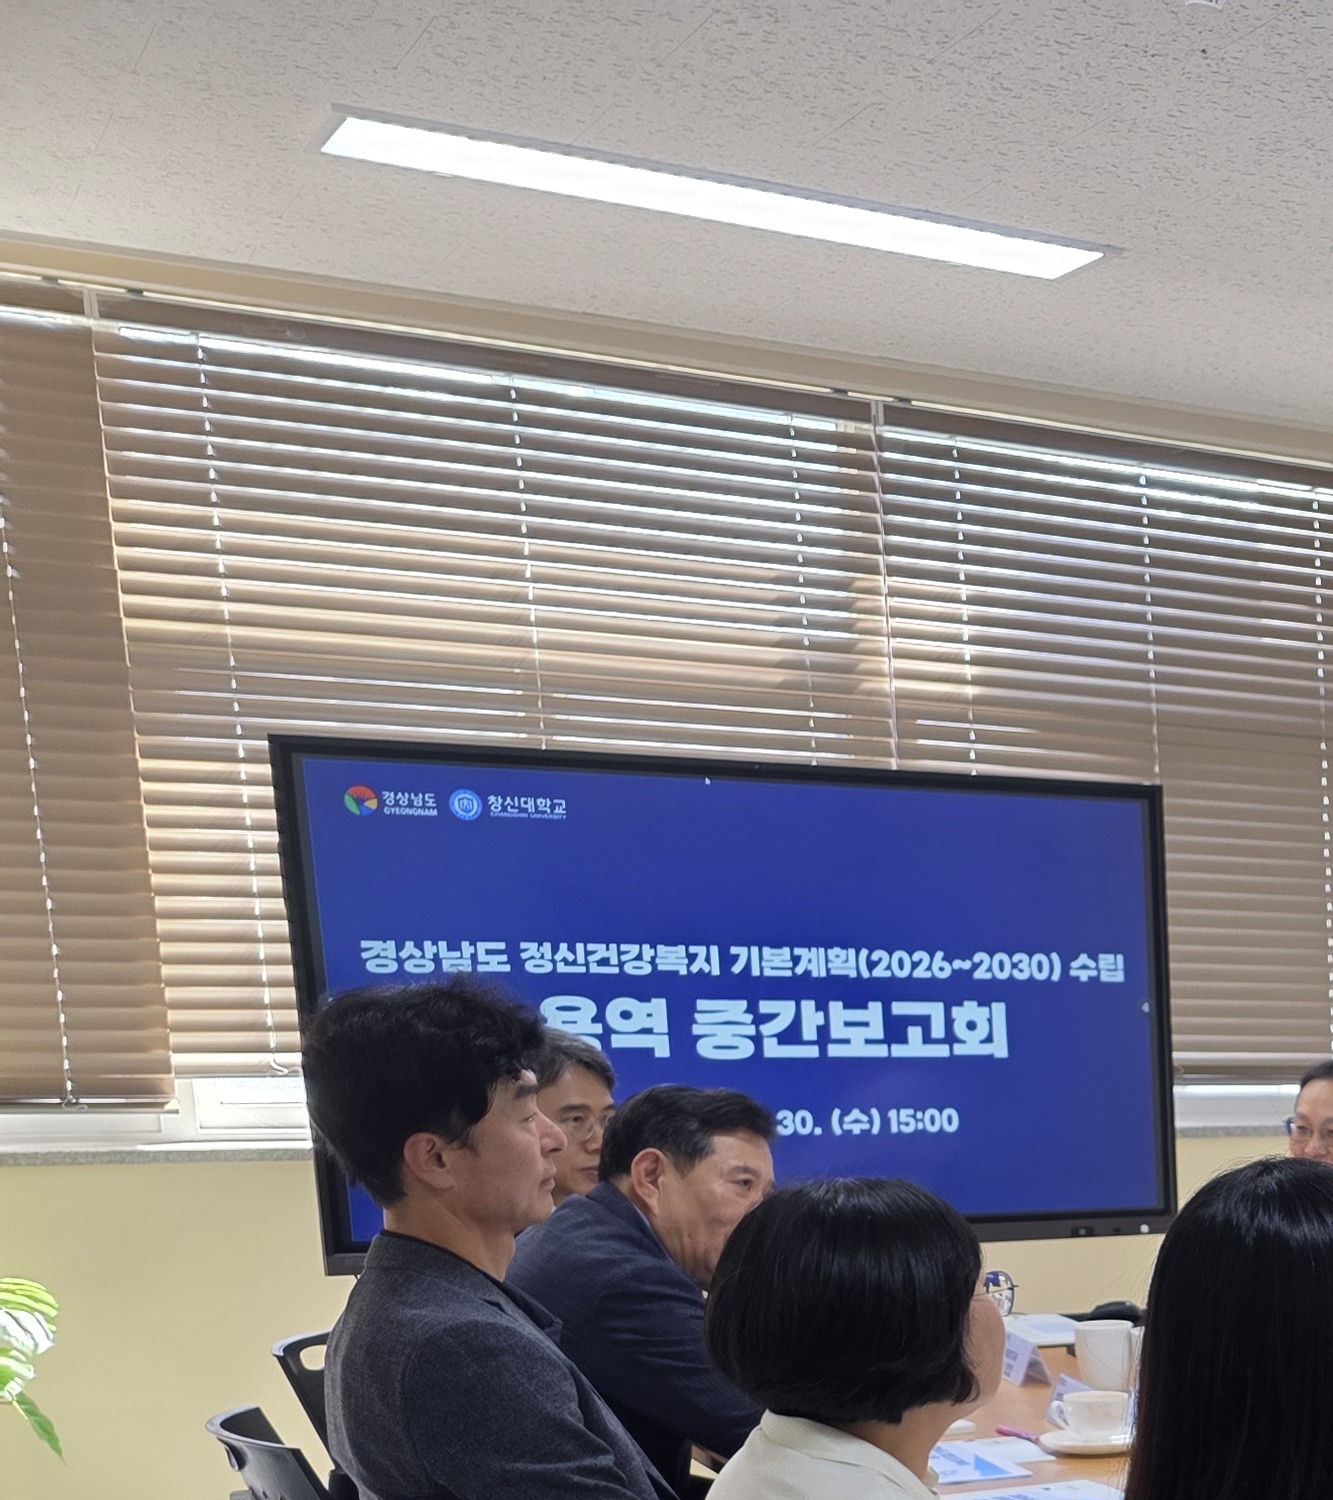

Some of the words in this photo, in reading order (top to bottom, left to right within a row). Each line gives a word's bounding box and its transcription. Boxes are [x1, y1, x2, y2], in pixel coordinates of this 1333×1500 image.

[381, 790, 437, 807] 경상남도
[487, 794, 567, 815] 창신대학교
[383, 806, 438, 817] GYEONGNAM
[360, 940, 511, 974] 경상남도
[519, 941, 721, 976] 정신건강복지
[730, 945, 1061, 982] 기본계획(2026~2030)
[1068, 952, 1125, 983] 수립
[692, 998, 1009, 1061] 중간보고회
[776, 1109, 823, 1136] 30.
[831, 1107, 881, 1136] (수)
[888, 1108, 959, 1133] 15:00
